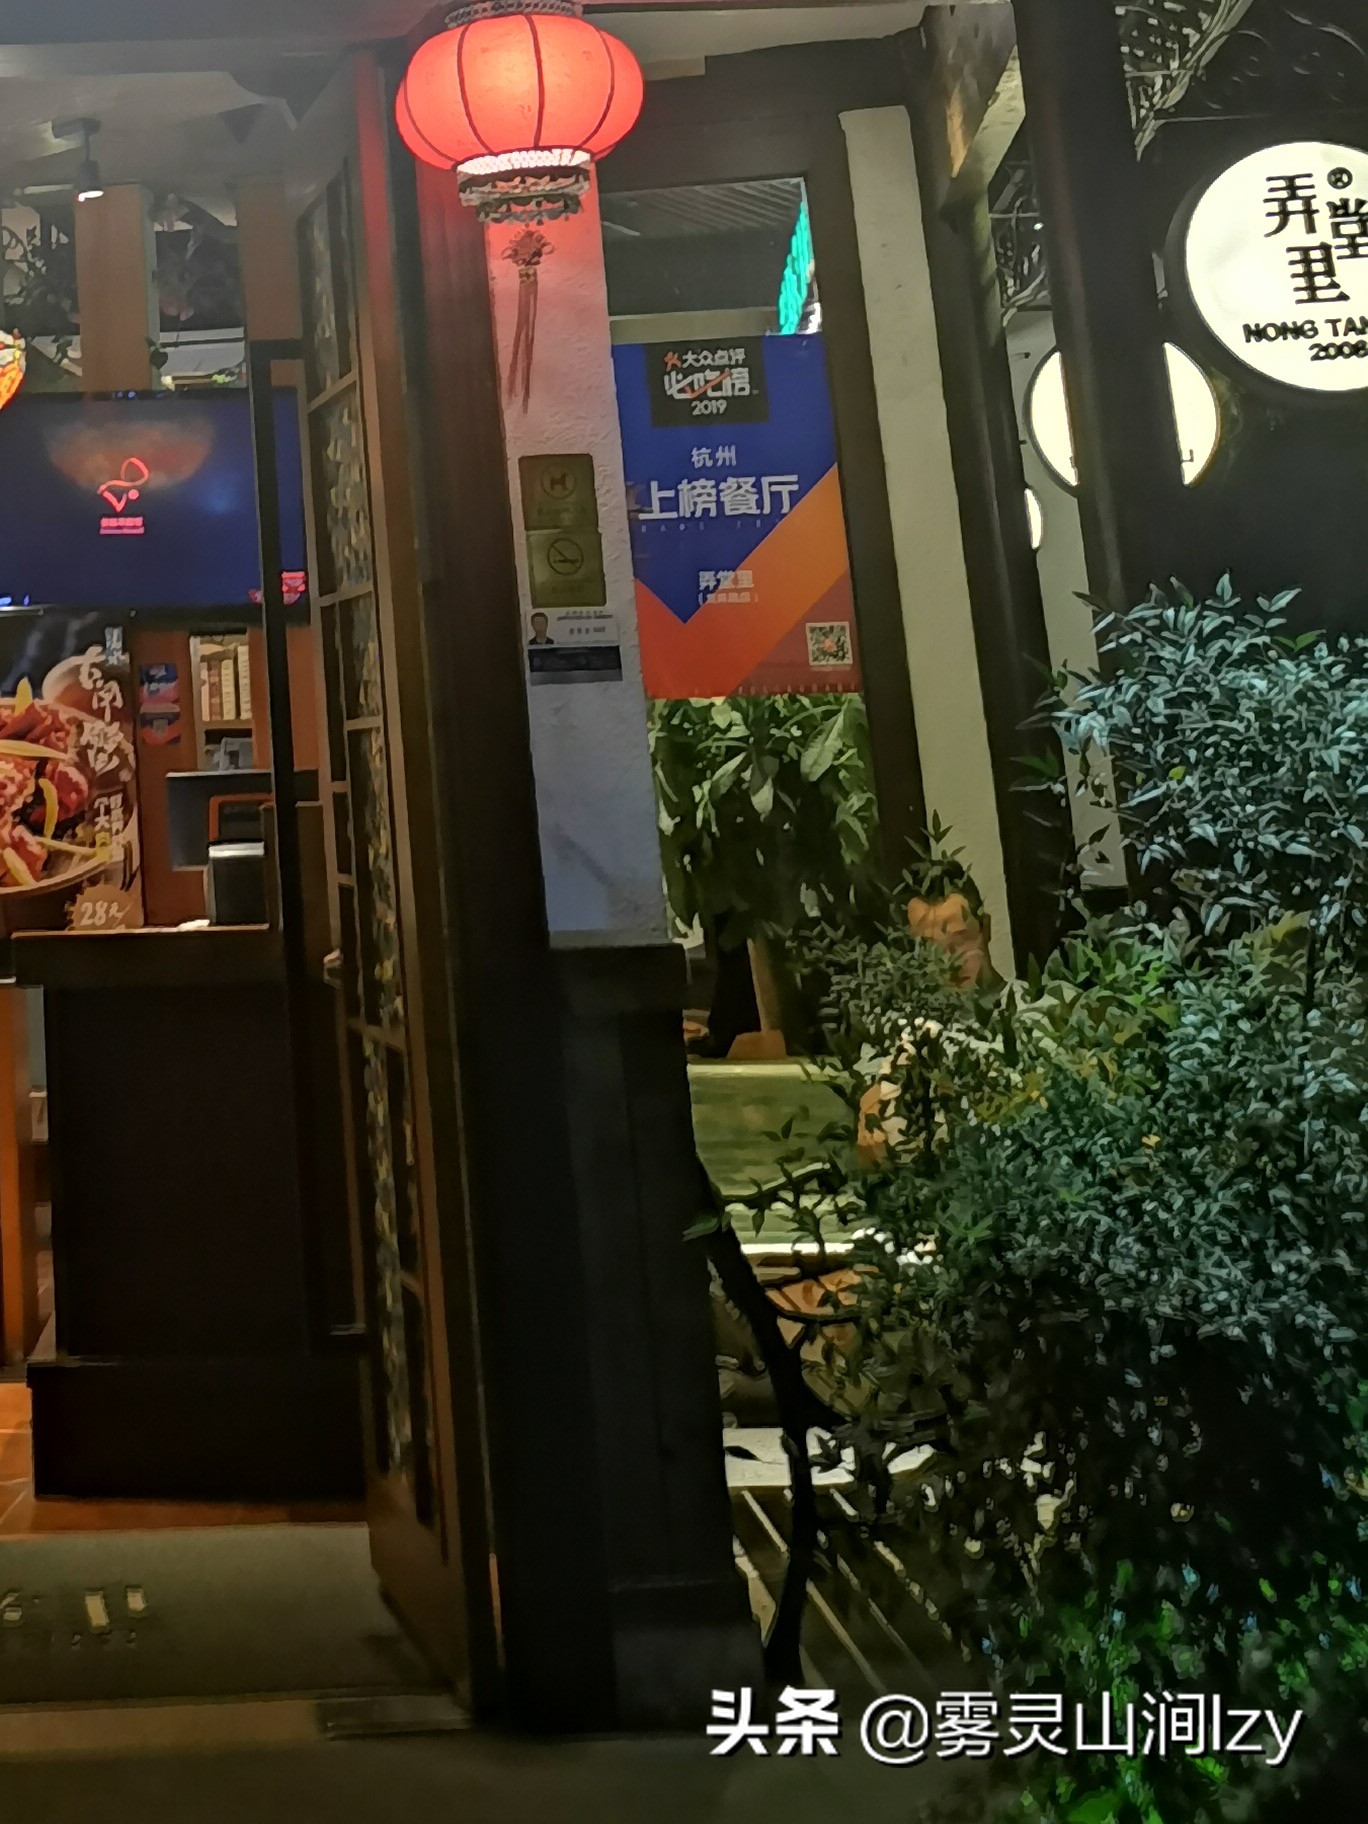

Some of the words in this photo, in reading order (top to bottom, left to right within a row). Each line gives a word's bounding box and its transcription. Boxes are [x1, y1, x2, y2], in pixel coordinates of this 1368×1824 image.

[682, 348, 746, 368] 大众点评
[664, 367, 750, 399] 必吃榜
[691, 399, 727, 416] 2019
[691, 445, 736, 468] 杭州
[638, 474, 799, 521] 上榜餐厅
